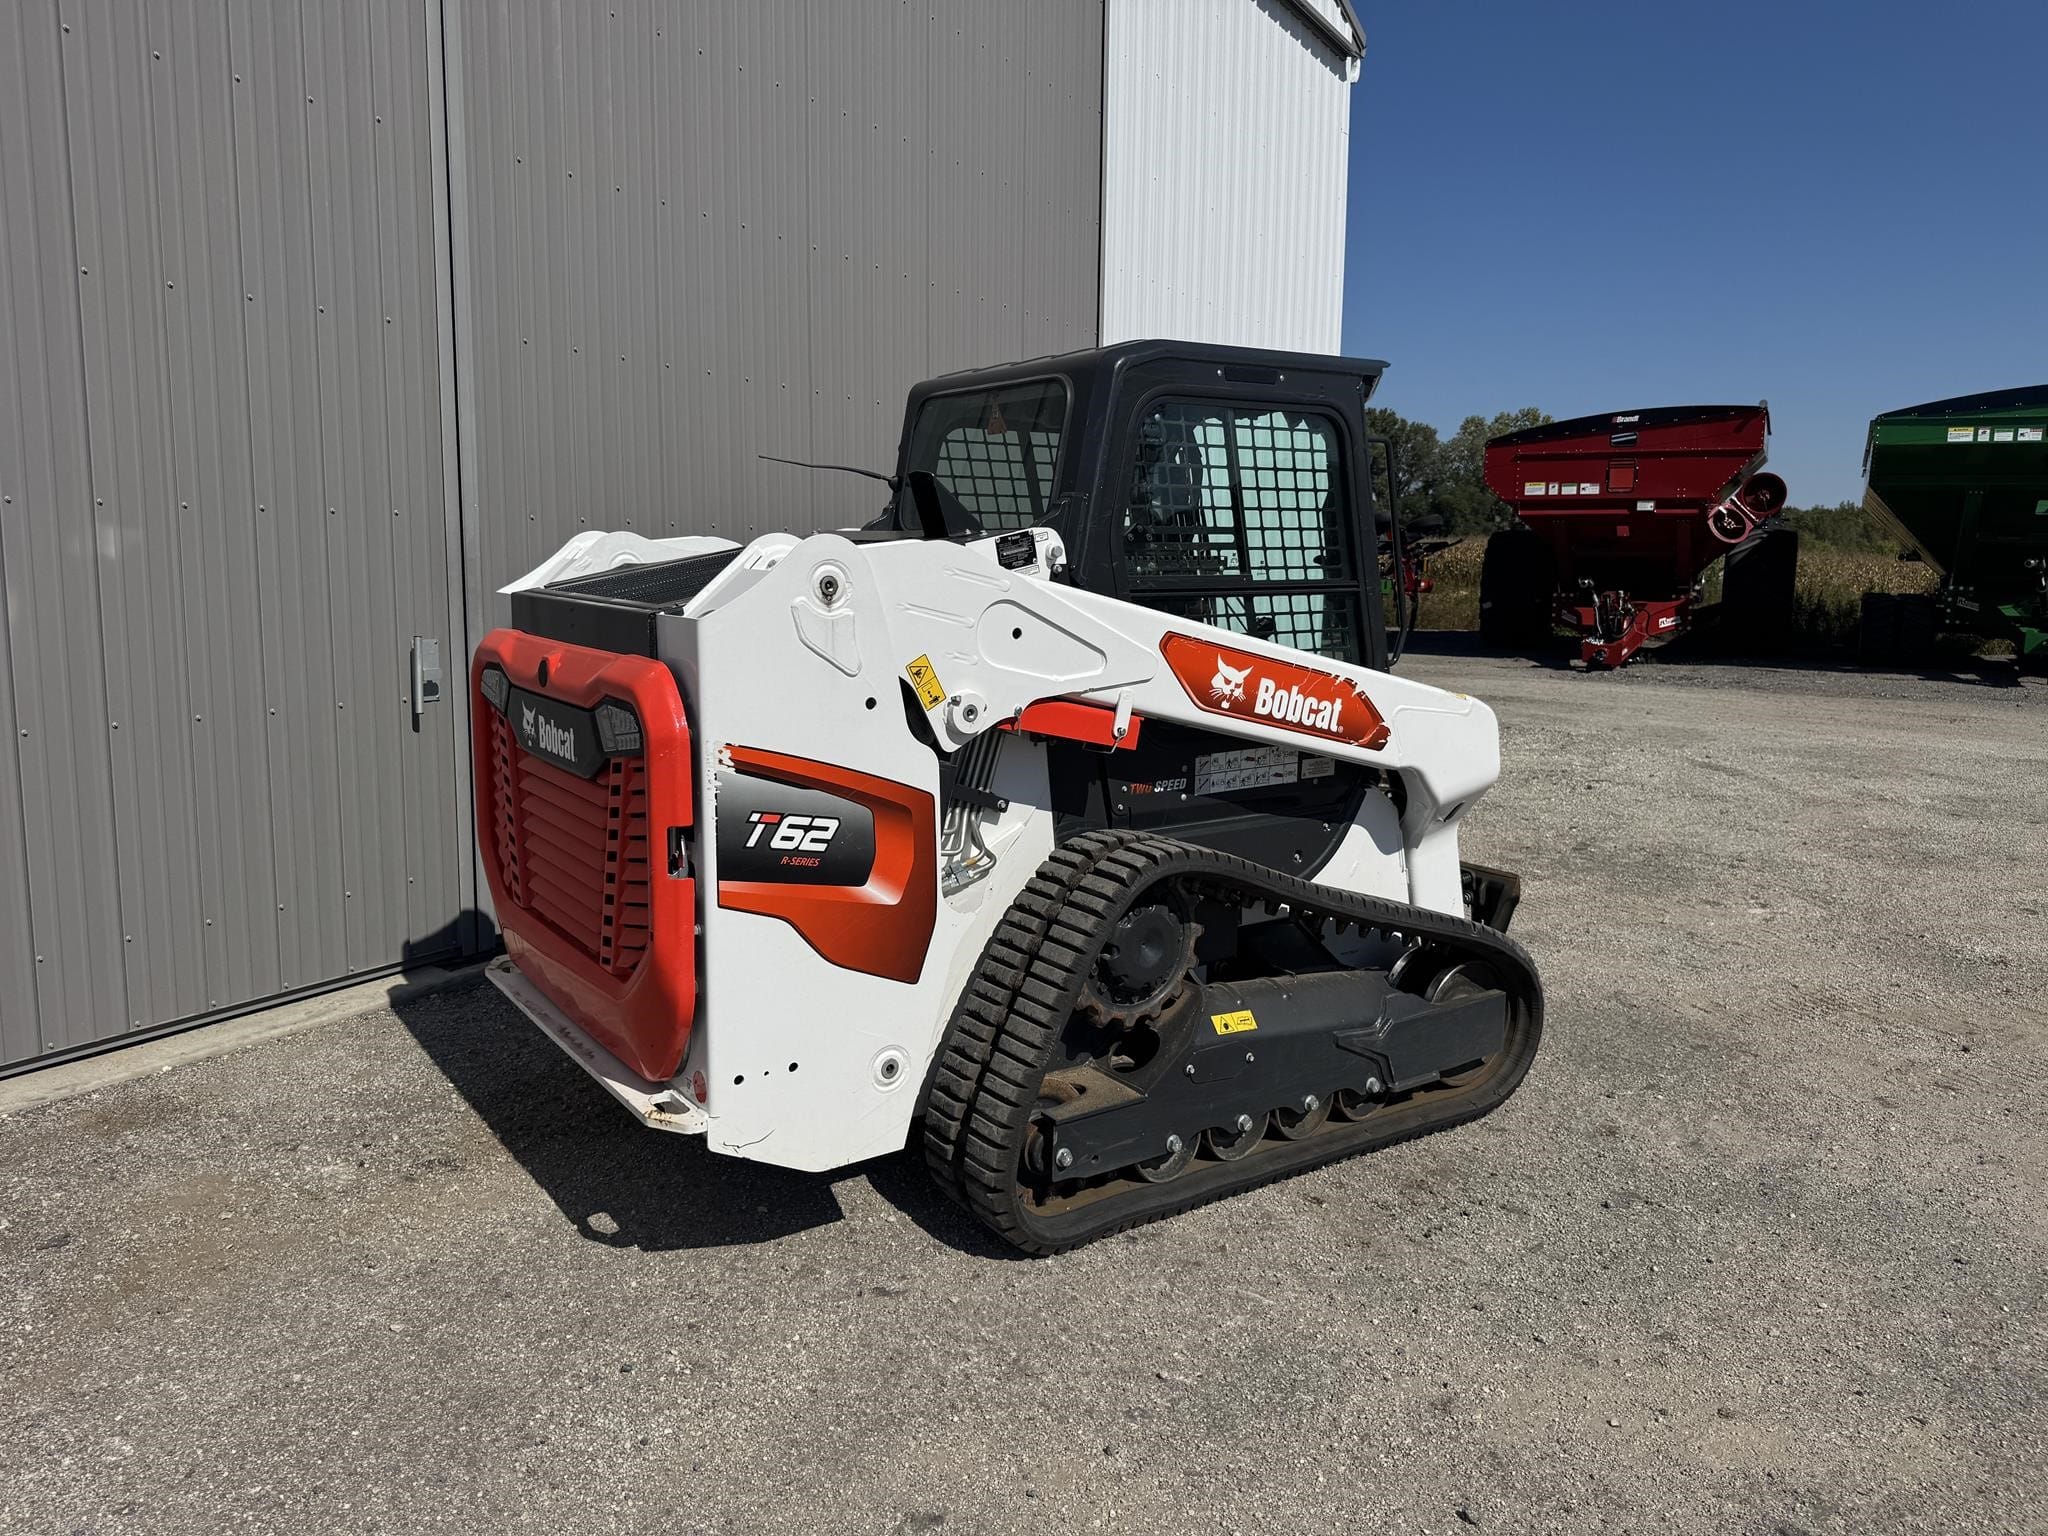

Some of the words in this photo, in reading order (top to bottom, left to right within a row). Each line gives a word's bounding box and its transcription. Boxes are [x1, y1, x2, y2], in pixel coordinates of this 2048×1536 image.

[1254, 677, 1342, 732] Bobcat
[538, 714, 575, 762] Bobcat
[1154, 778, 1187, 793] SPEED
[744, 811, 840, 852] T62
[780, 856, 821, 867] R-SERIES
